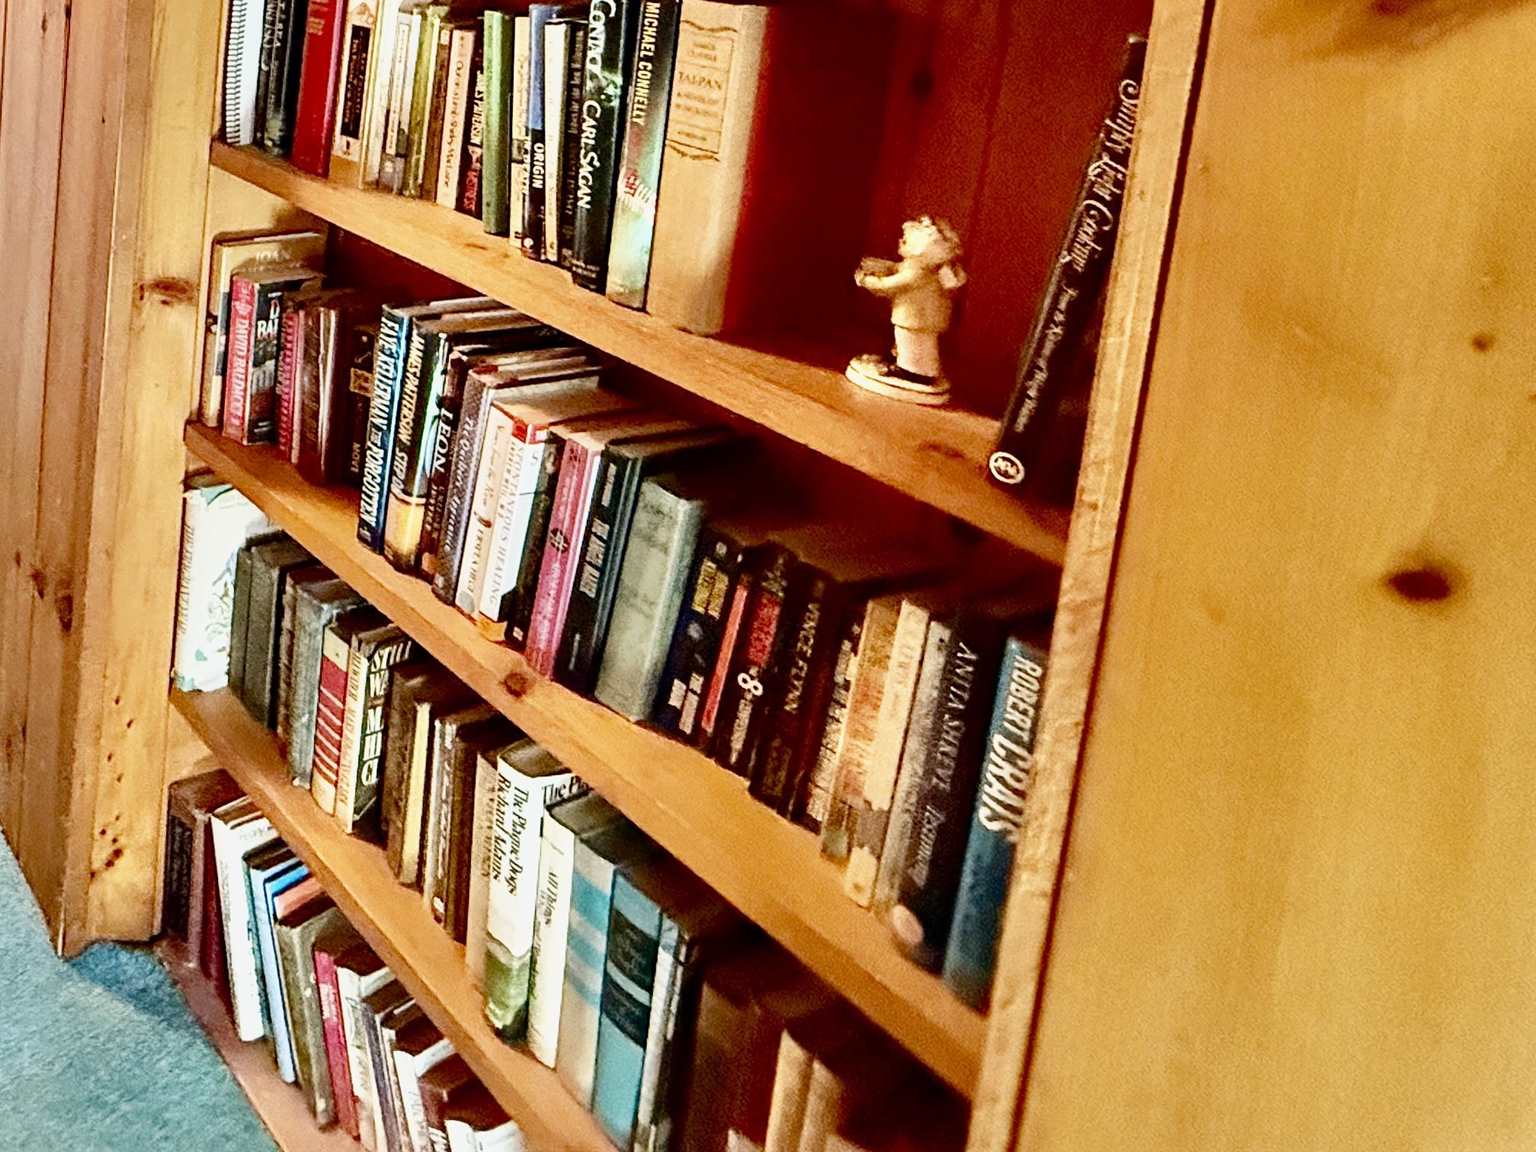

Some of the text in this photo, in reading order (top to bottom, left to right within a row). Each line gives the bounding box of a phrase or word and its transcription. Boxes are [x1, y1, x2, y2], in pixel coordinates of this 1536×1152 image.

[630, 0, 661, 126] MICHAEL CONNELLY
[531, 141, 545, 189] ORIGIN
[576, 98, 601, 211] CARL SAGAN
[1086, 154, 1127, 200] Light
[1059, 200, 1114, 272] Cooking
[377, 316, 400, 355] FAYE
[369, 348, 395, 431] KELLERMAN
[397, 328, 426, 447] JAMES PATTERSON
[393, 447, 408, 482] STEP
[434, 406, 454, 474] LEON
[359, 441, 384, 527] FORGOTTEN
[929, 641, 980, 794] ANITA SHREVE
[972, 654, 1045, 845] ROBERT CRAIS
[490, 772, 514, 885] Richard Adams
[542, 780, 567, 805] The
[502, 785, 529, 899] The Plague Dogs
